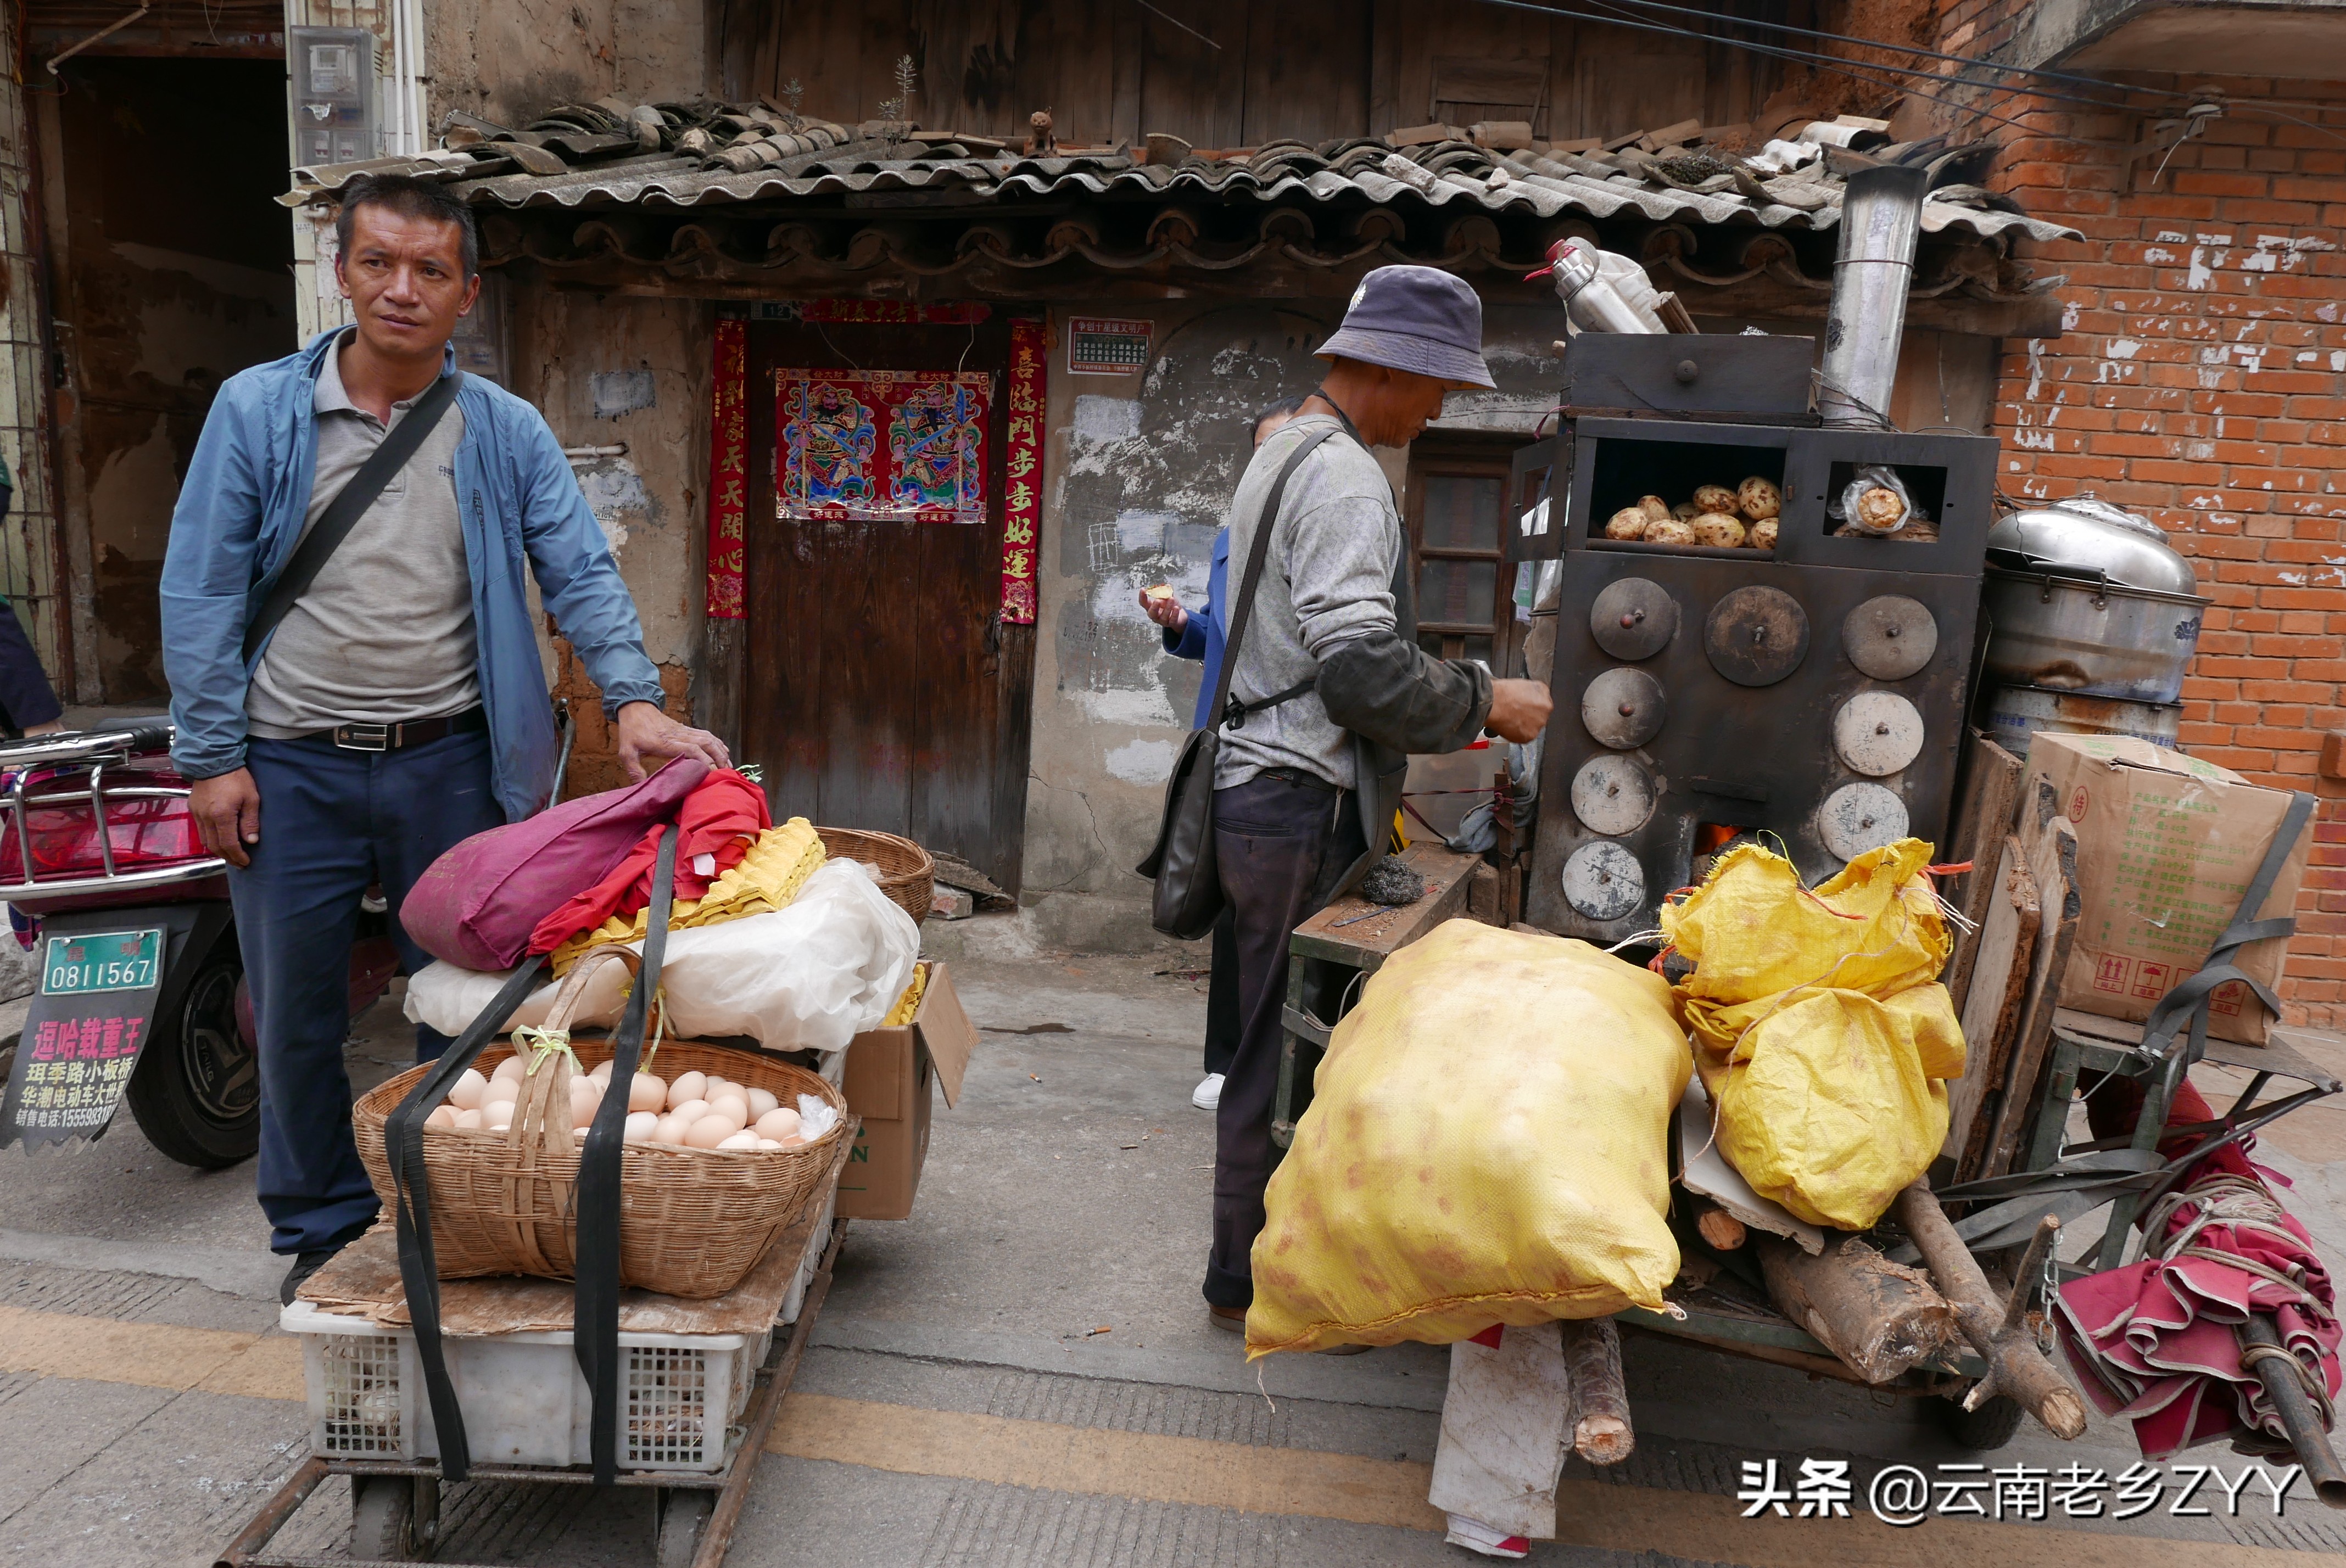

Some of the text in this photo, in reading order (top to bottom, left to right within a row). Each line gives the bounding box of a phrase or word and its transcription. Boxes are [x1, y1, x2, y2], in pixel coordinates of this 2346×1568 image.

[1078, 321, 1144, 334] 争创十星级文明户
[813, 371, 844, 379] 發大財
[919, 373, 949, 382] 發大財
[2074, 794, 2085, 816] 特
[65, 941, 142, 961] 昆明
[52, 960, 150, 988] 0811567
[31, 1017, 144, 1061] 逗哈载重王
[25, 1057, 133, 1085] 珥季路小板桥
